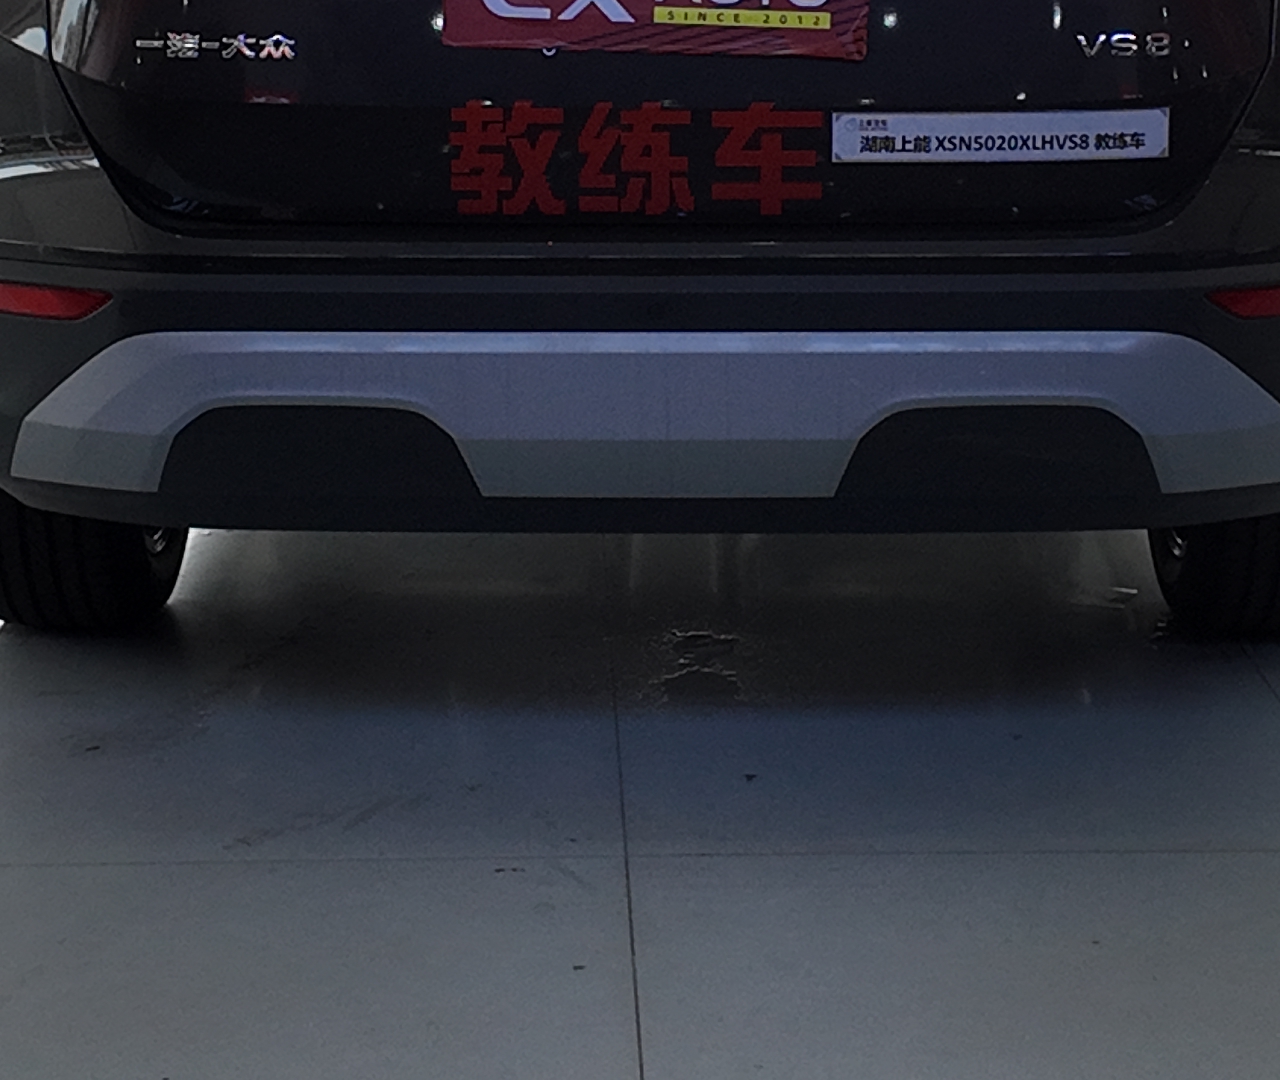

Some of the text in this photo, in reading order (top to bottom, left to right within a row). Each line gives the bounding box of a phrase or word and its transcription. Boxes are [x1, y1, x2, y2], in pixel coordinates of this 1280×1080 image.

[667, 10, 821, 26] SINCE 2012
[1076, 33, 1171, 58] VS8
[935, 133, 1090, 152] XSN5020XLHVS8
[449, 100, 822, 216] 教练车
